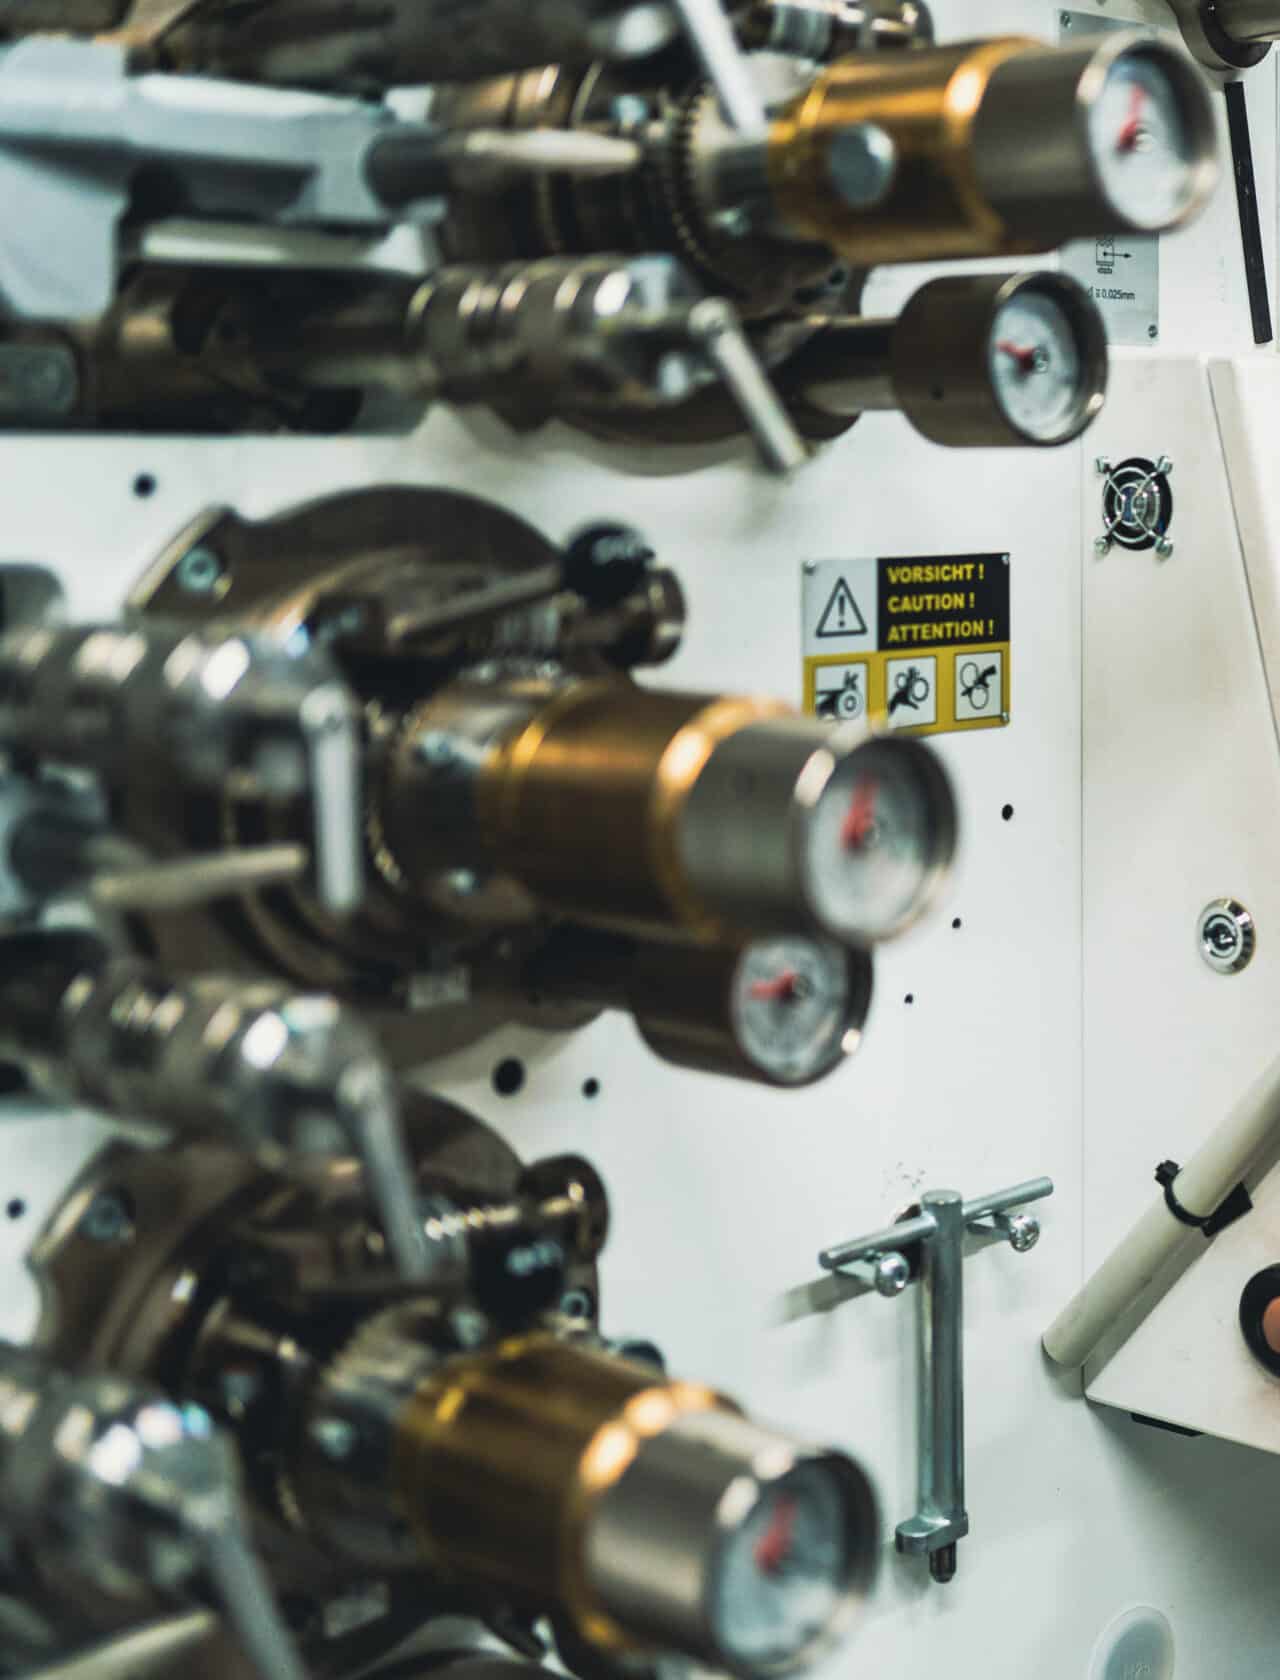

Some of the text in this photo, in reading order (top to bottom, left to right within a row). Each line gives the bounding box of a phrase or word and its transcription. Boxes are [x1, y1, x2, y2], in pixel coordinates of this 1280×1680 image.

[887, 563, 975, 584] VORSICHT
[887, 592, 966, 614] CAUTION
[887, 620, 984, 643] ATTENTION
